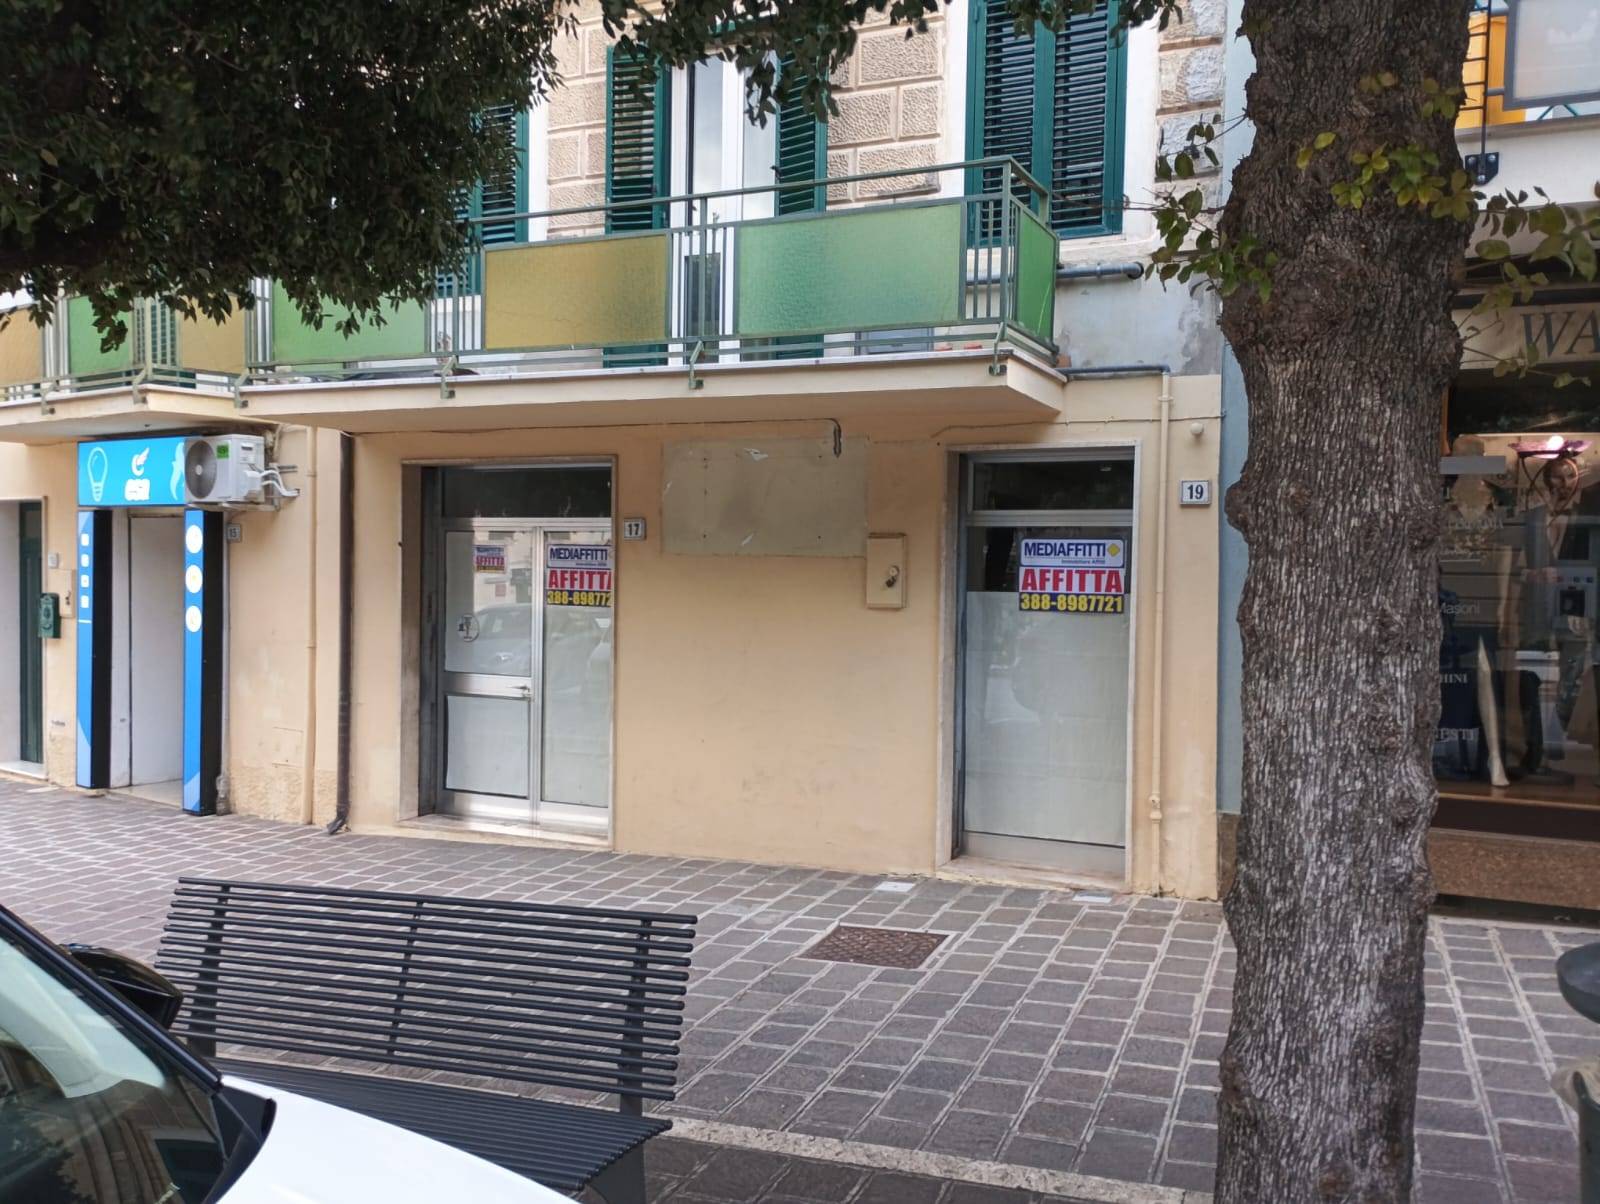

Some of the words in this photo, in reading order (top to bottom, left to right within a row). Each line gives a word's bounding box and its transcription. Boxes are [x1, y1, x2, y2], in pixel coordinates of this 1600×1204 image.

[1519, 309, 1600, 357] WA
[1187, 484, 1204, 500] 19
[628, 523, 640, 536] 17
[549, 547, 608, 561] MEDIAFFITTI
[1024, 542, 1106, 557] MEDIAFFITTI
[1021, 568, 1123, 593] AFFITTA
[1020, 592, 1123, 612] 388-8987721
